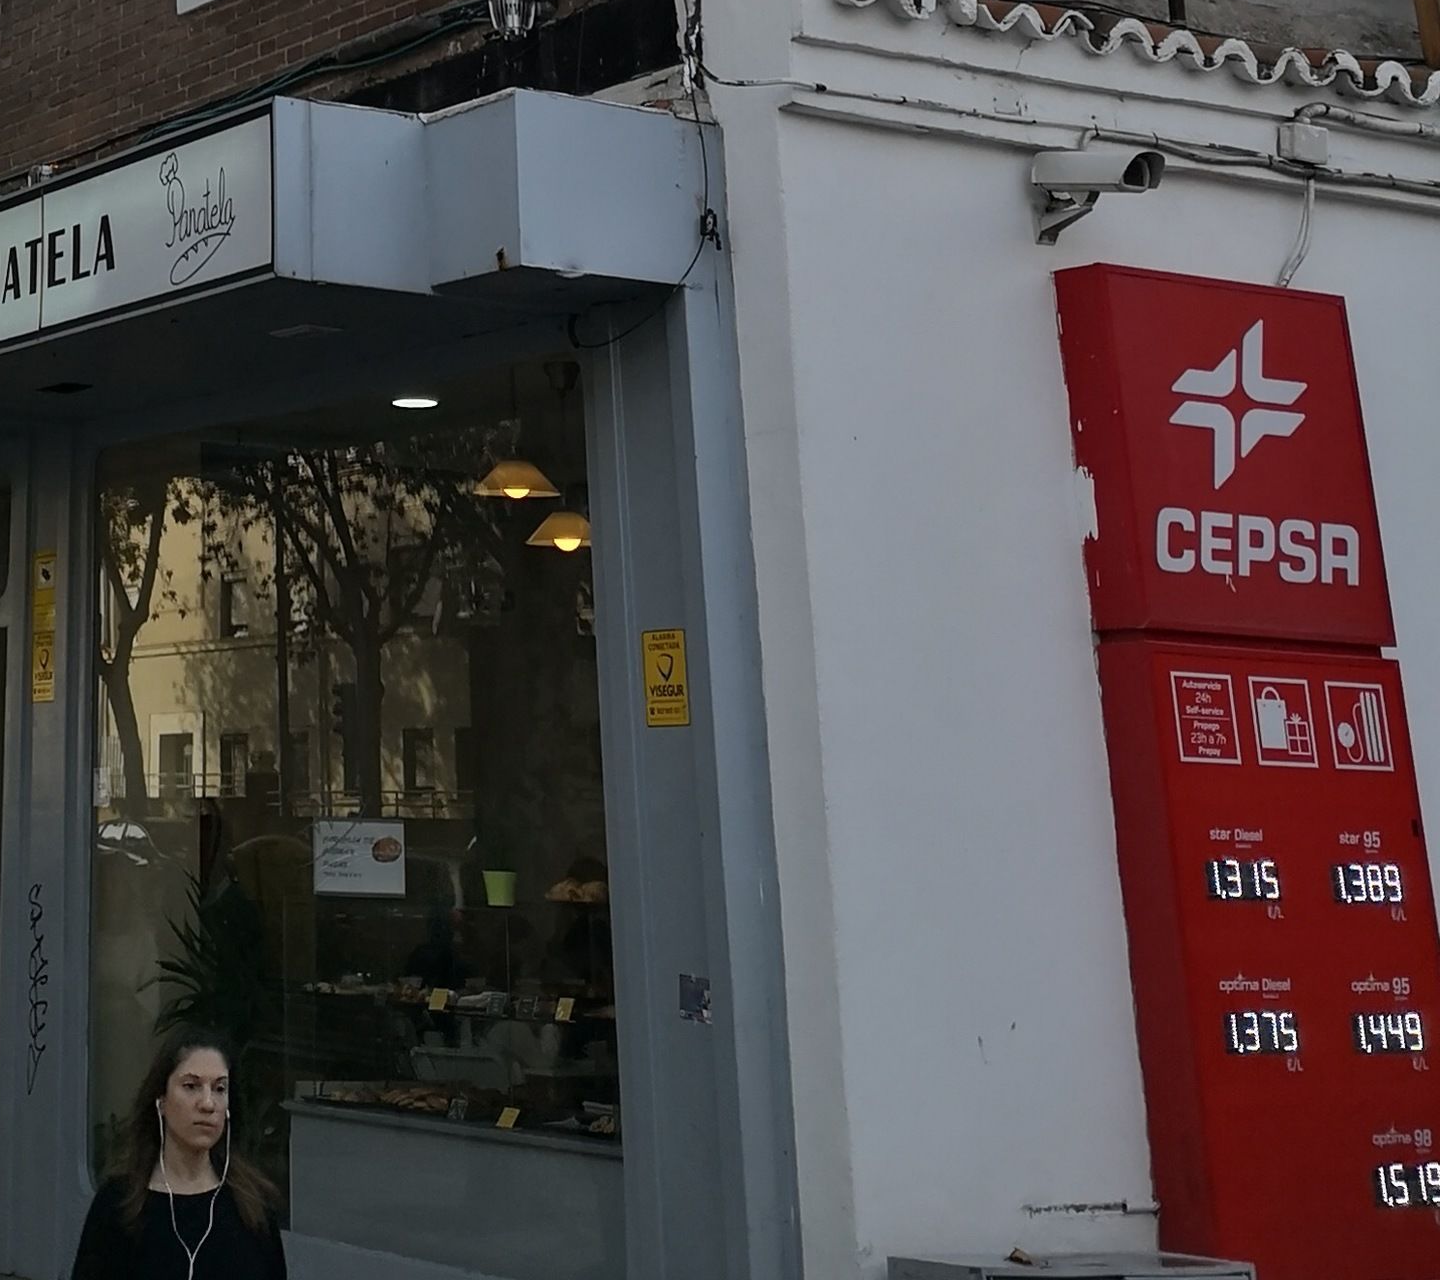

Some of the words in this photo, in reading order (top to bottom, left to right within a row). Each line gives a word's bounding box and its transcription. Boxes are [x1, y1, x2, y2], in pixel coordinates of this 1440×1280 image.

[165, 166, 235, 248] Panatela
[1156, 507, 1360, 586] CEPSA
[649, 684, 685, 697] VISEGUR
[1195, 692, 1212, 703] 24h
[1185, 705, 1224, 716] Self-service
[1190, 732, 1207, 744] 23h
[1209, 828, 1231, 841] star
[1234, 828, 1263, 842] Diesel
[1339, 832, 1360, 845] star
[1363, 831, 1381, 849] 95
[1212, 859, 1280, 900] 1,315
[1336, 863, 1403, 904] 1,389
[1219, 973, 1260, 994] optima
[1262, 978, 1291, 992] Diesel
[1351, 972, 1390, 994] optima
[1392, 977, 1410, 995] 95
[1229, 1012, 1298, 1054] 1,375
[1356, 1012, 1424, 1054] 1,449
[1372, 1125, 1412, 1148] optima
[1414, 1129, 1432, 1147] 98
